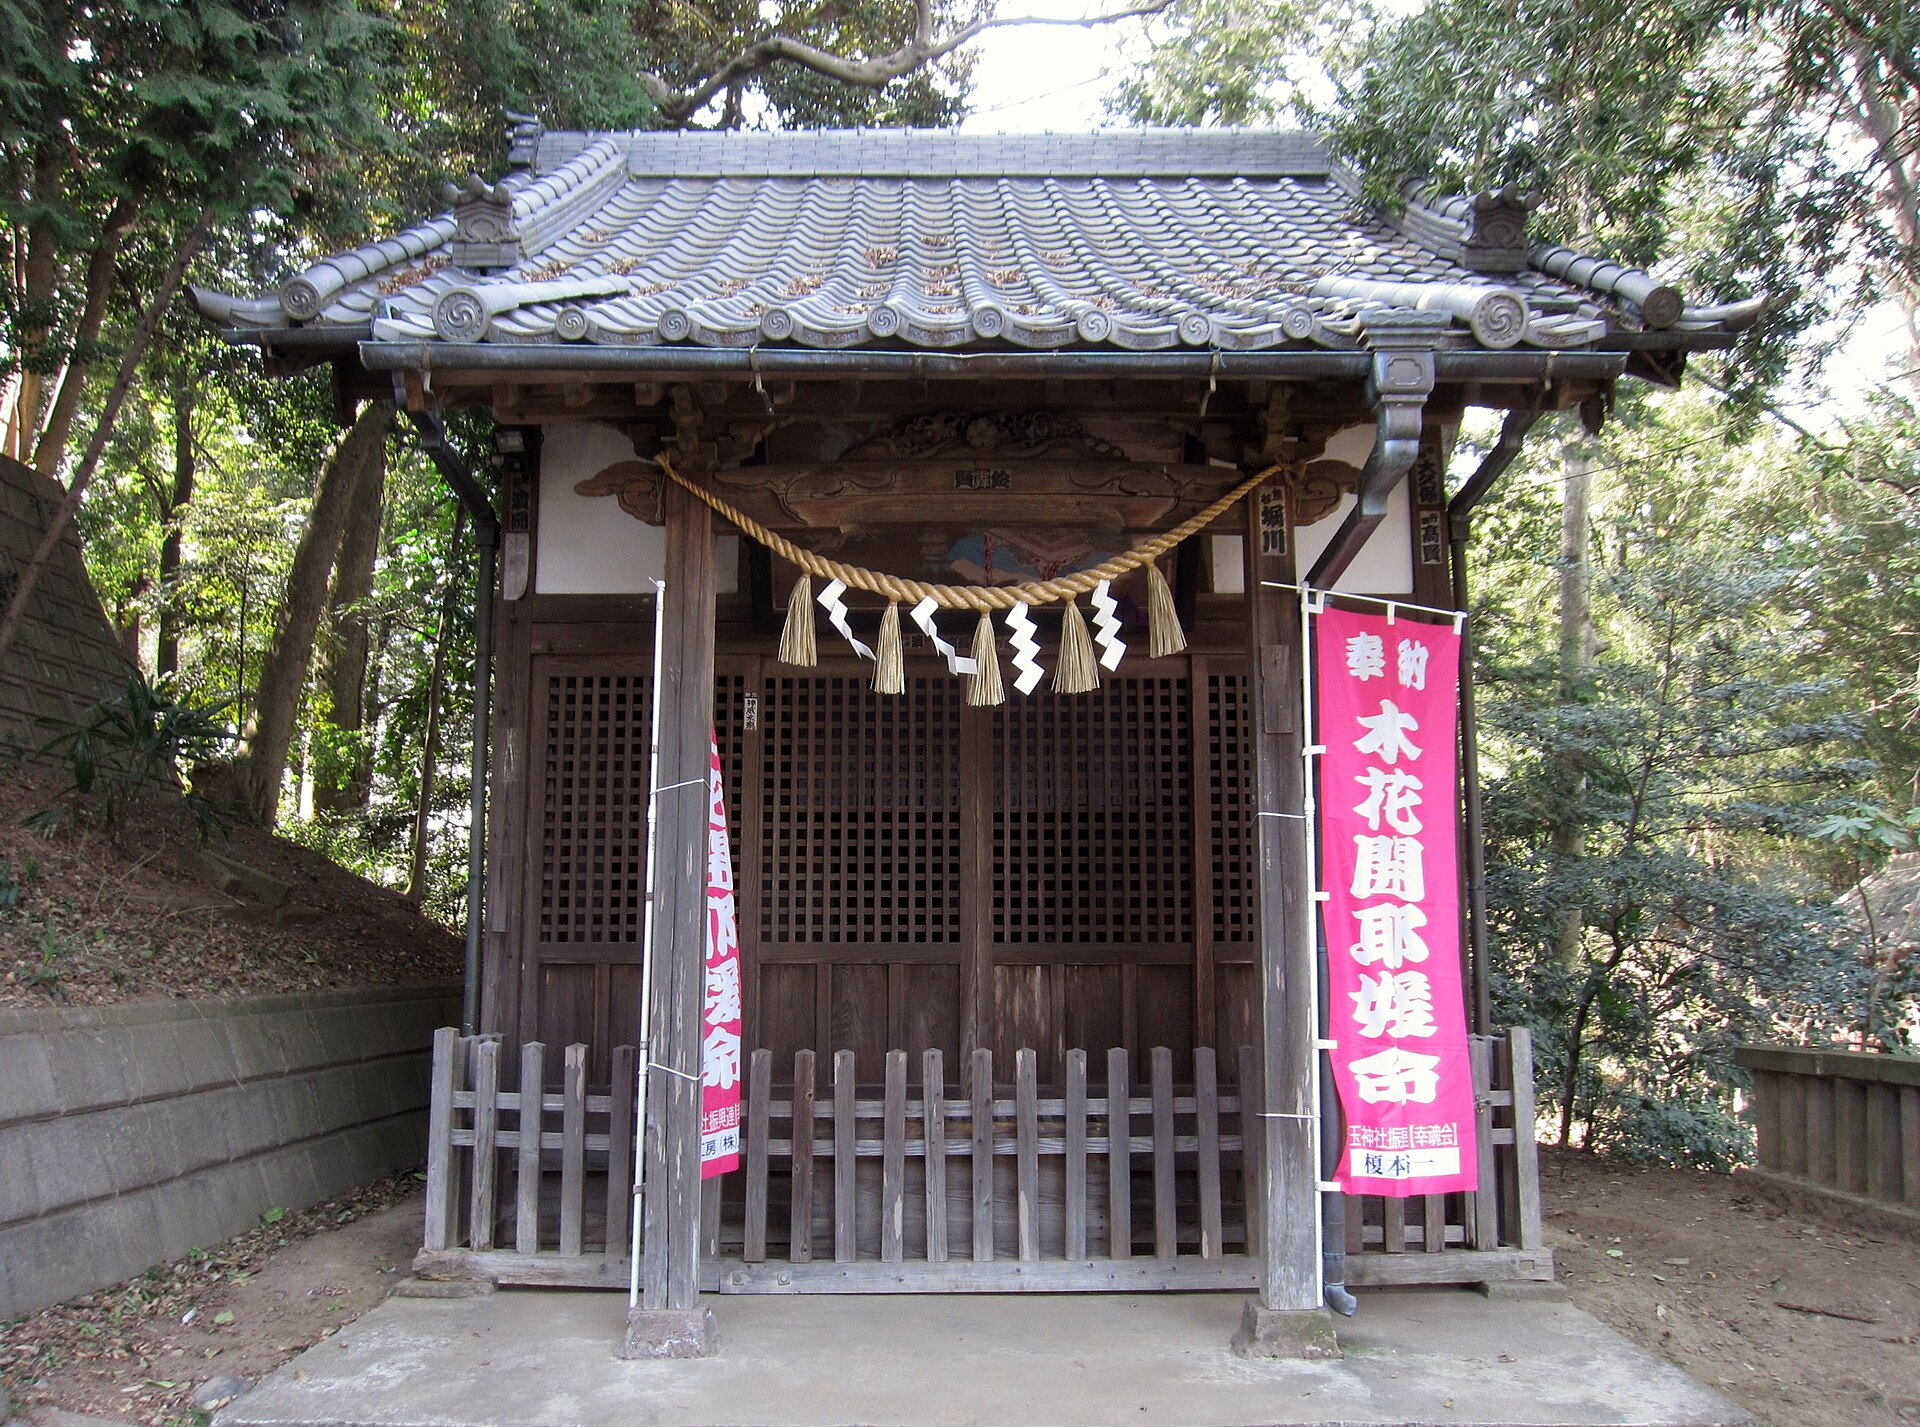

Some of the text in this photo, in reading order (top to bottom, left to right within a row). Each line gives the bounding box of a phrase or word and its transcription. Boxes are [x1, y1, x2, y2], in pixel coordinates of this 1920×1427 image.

[1261, 503, 1286, 554] 堀川
[1346, 631, 1430, 691] 奉納
[703, 742, 741, 1089] 開耶媛命
[1348, 699, 1442, 1106] 木花開耶媛命
[1364, 1153, 1434, 1176] 榎本一
